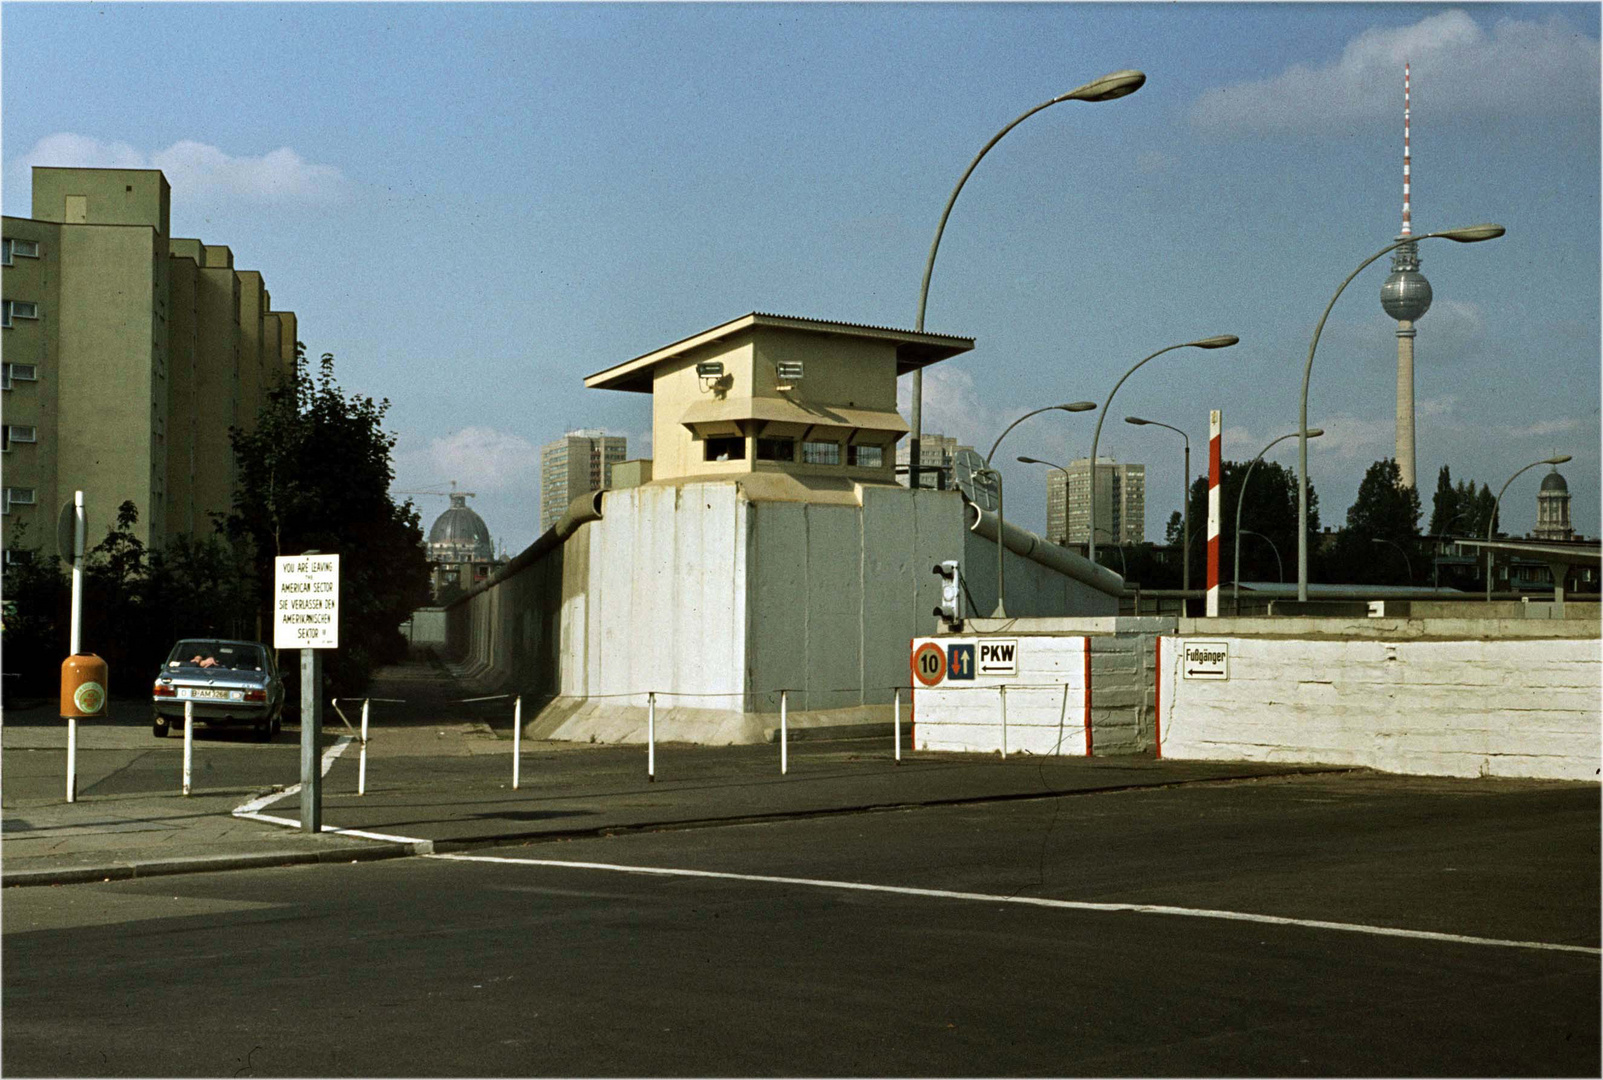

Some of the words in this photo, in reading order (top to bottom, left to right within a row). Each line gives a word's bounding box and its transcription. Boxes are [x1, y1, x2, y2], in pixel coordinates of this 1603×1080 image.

[283, 563, 294, 573] YOU
[297, 562, 308, 572] ARE
[311, 562, 332, 572] LEAVING
[281, 583, 310, 593] AMERICAN
[313, 582, 333, 593] SECTOR
[279, 599, 288, 609] SIE
[291, 599, 322, 609] VERLASSEN
[325, 599, 335, 609] DEN
[282, 614, 331, 624] AMERIKANISCHEN
[298, 628, 318, 638] SEKTOR
[981, 645, 1015, 662] PKW
[1186, 648, 1226, 665] Fußgänger
[921, 654, 939, 673] 10
